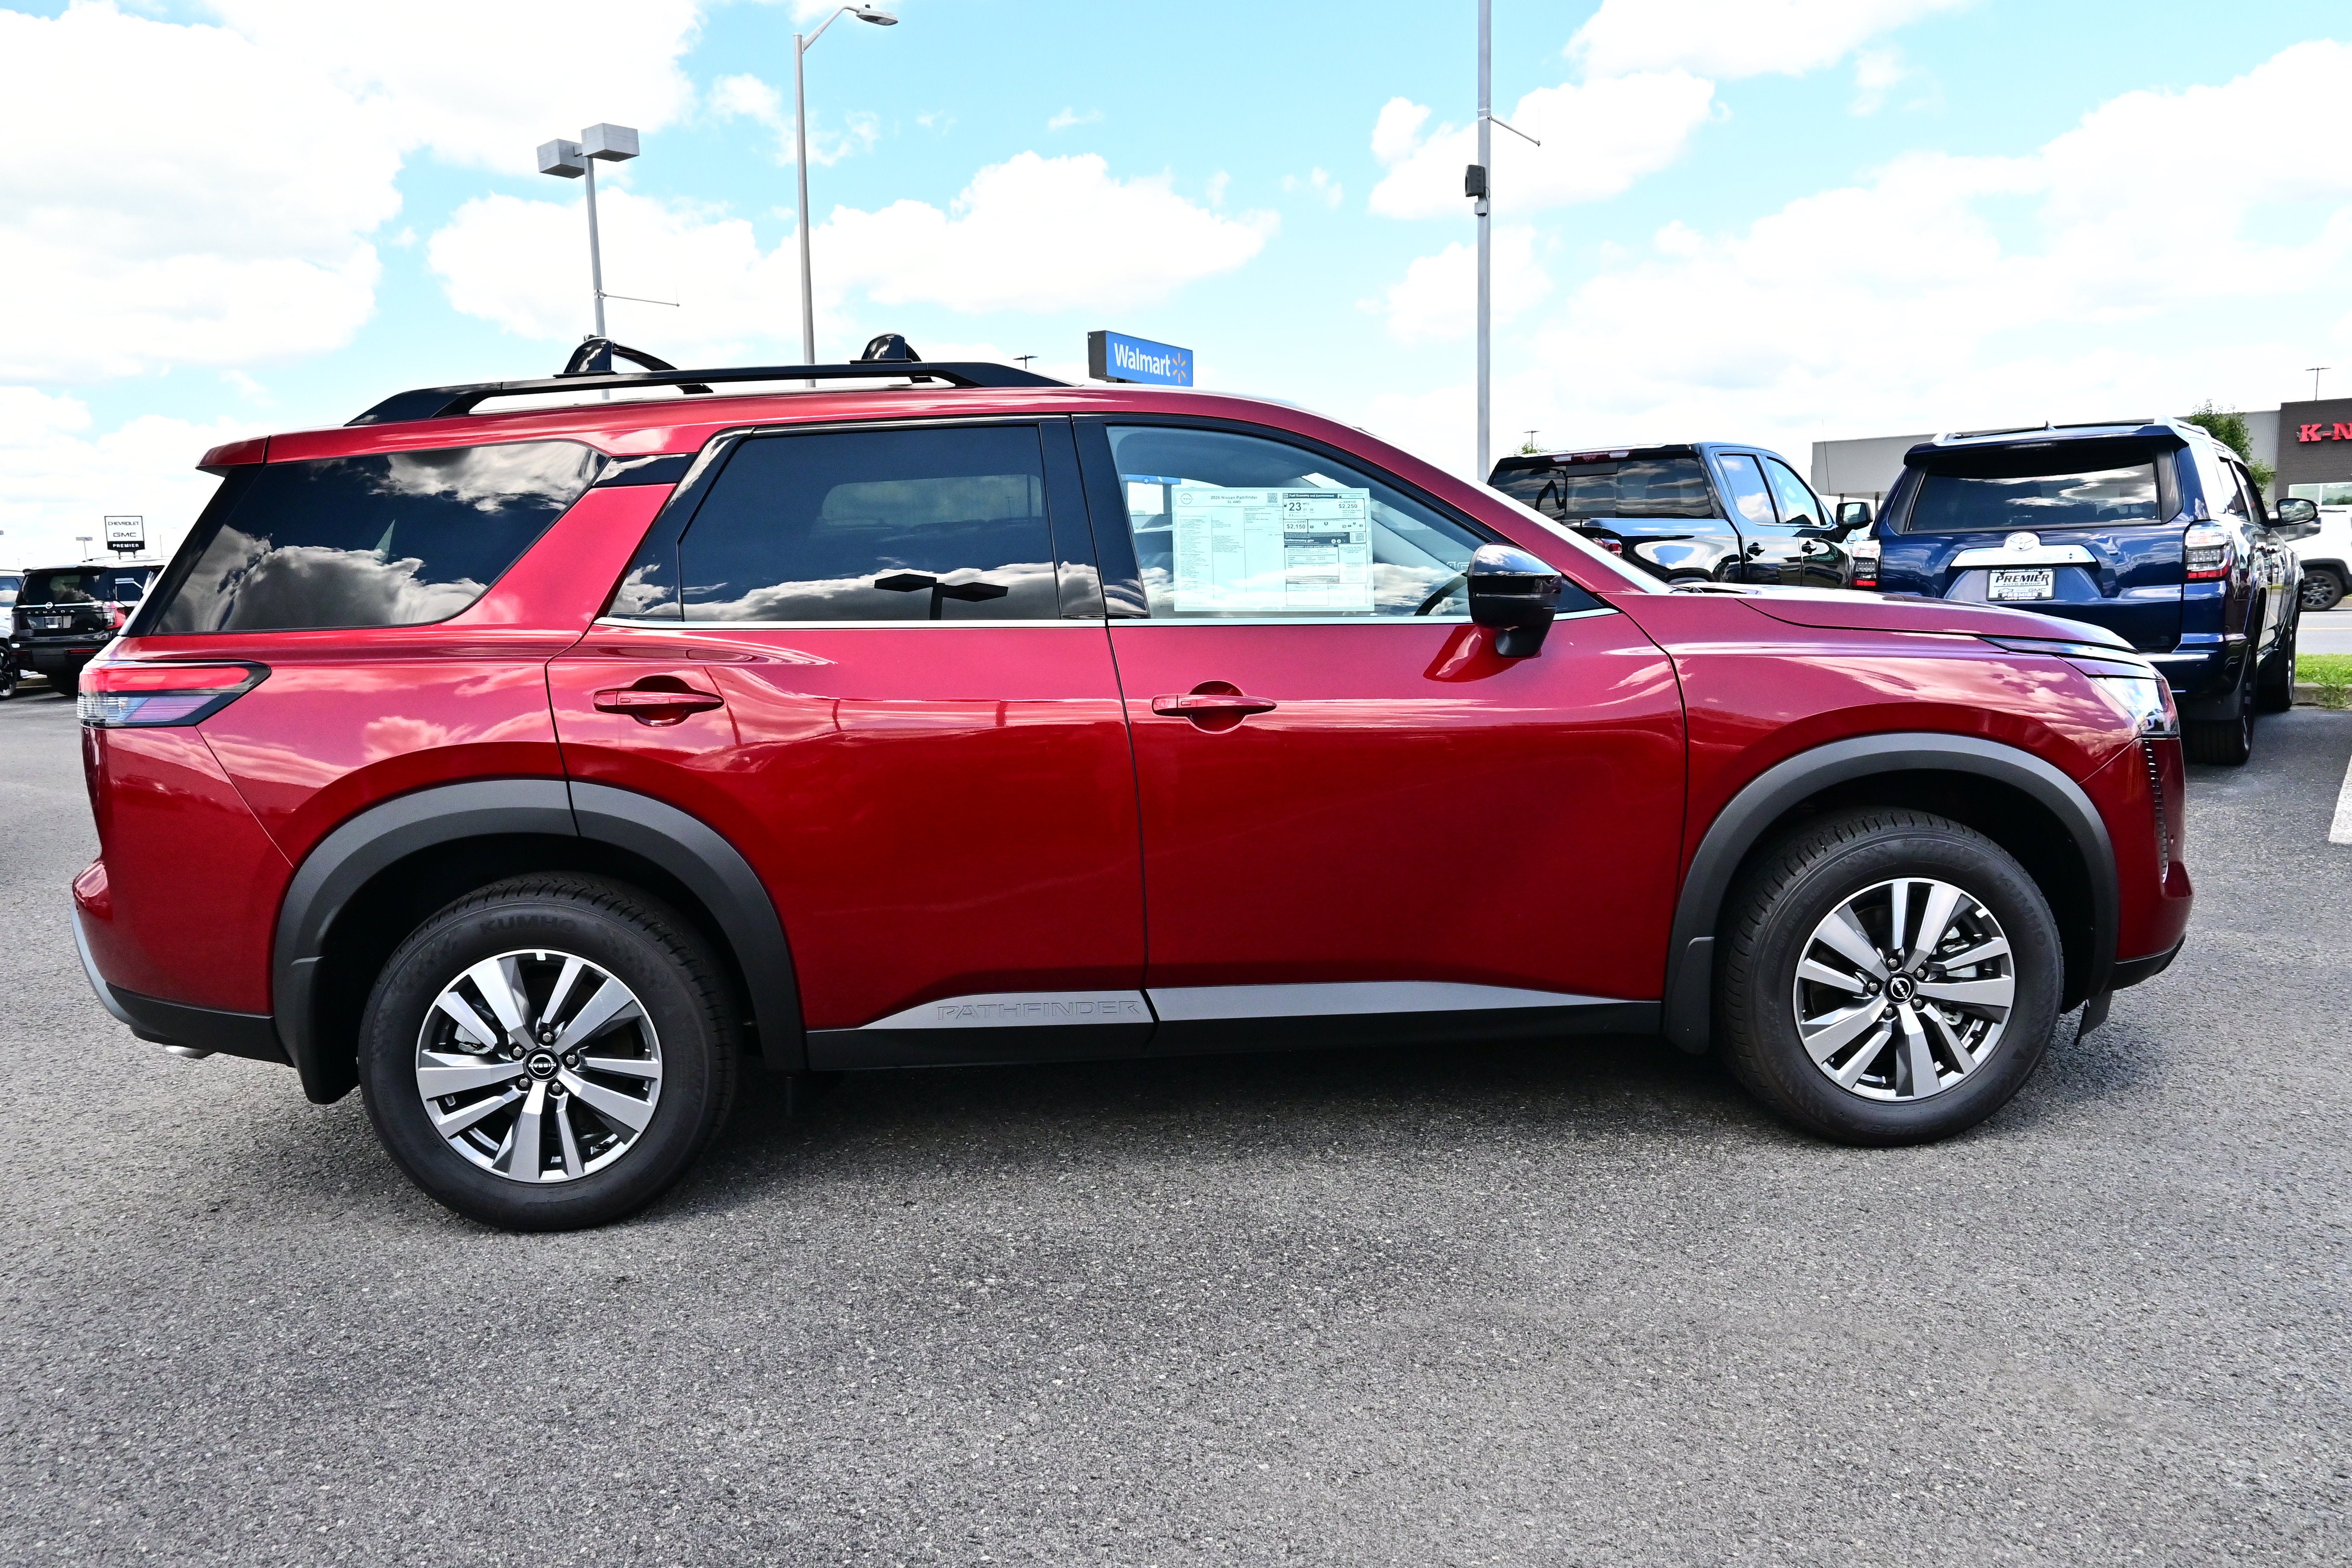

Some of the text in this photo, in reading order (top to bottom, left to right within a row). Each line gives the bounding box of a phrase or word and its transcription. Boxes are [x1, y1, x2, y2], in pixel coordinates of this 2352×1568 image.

[1114, 343, 1170, 376] Walmart
[1289, 502, 1301, 511] 23
[1995, 574, 2050, 585] PREMIER
[480, 916, 577, 934] KUMHO
[1892, 977, 1909, 999] NISSAN
[937, 1000, 1140, 1020] PATHFINDER
